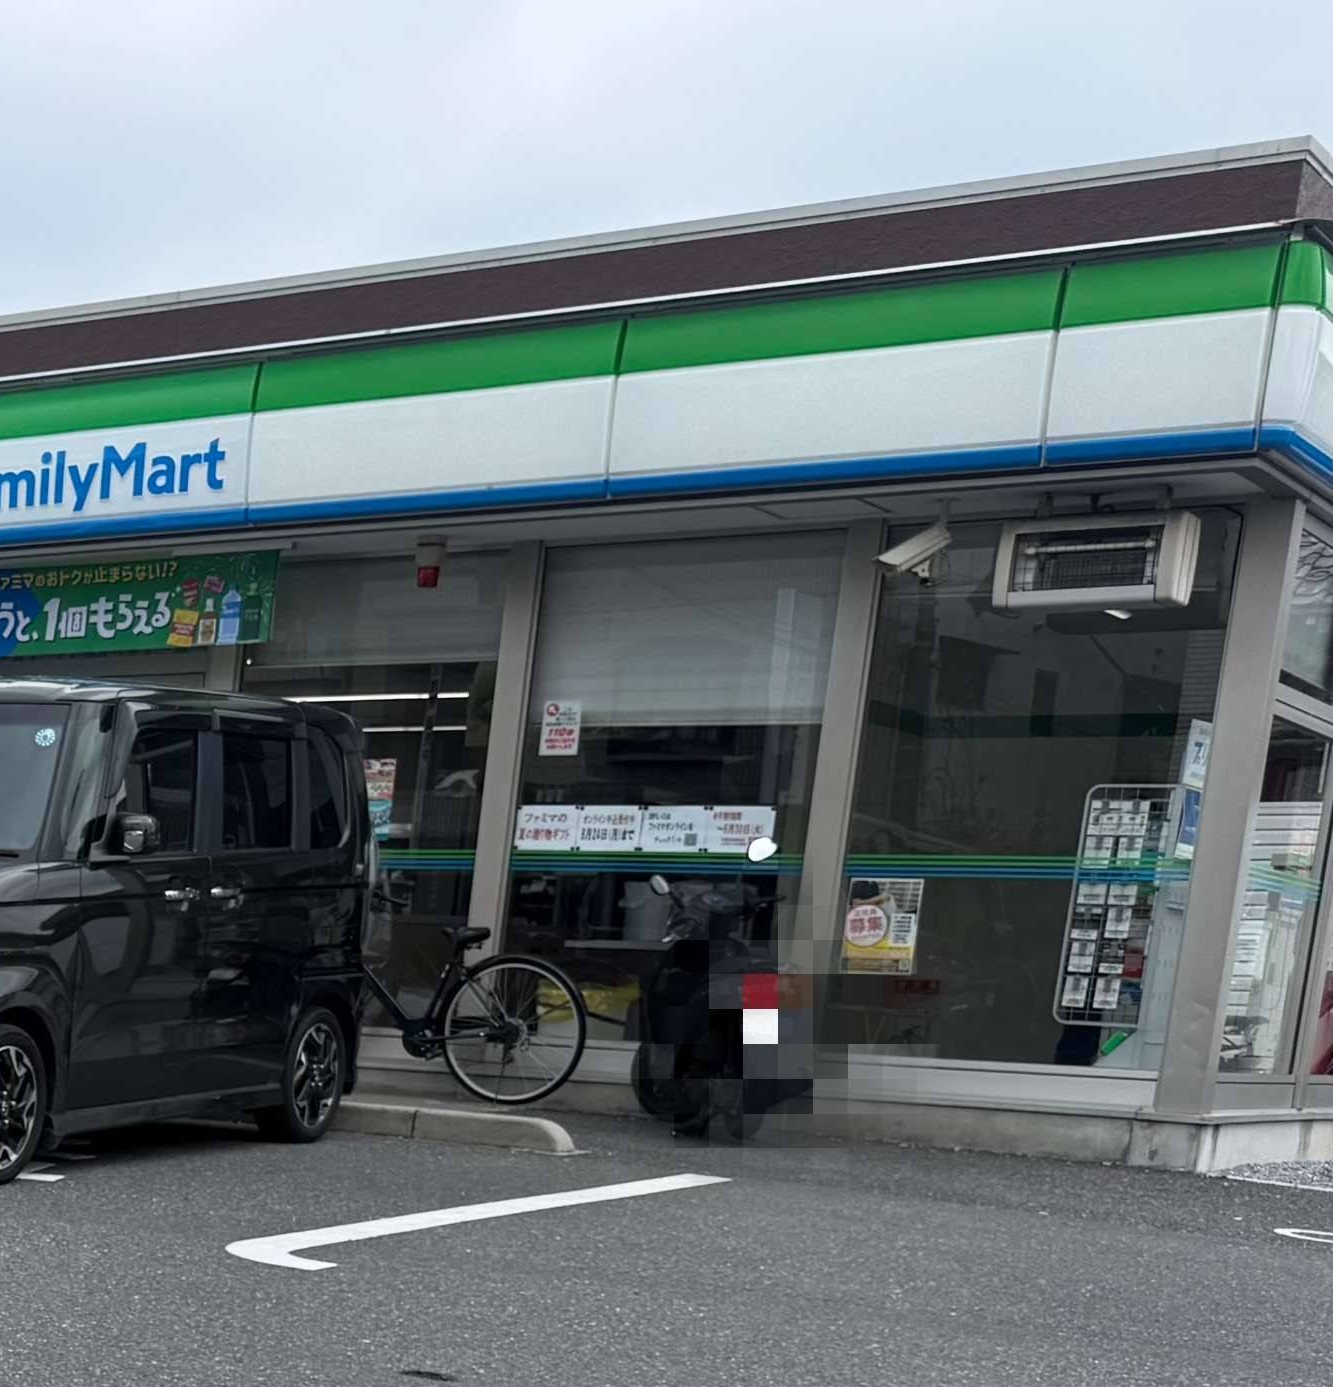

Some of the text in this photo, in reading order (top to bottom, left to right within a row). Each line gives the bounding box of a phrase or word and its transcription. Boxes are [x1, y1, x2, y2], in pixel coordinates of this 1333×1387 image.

[524, 813, 567, 823] ファミマの
